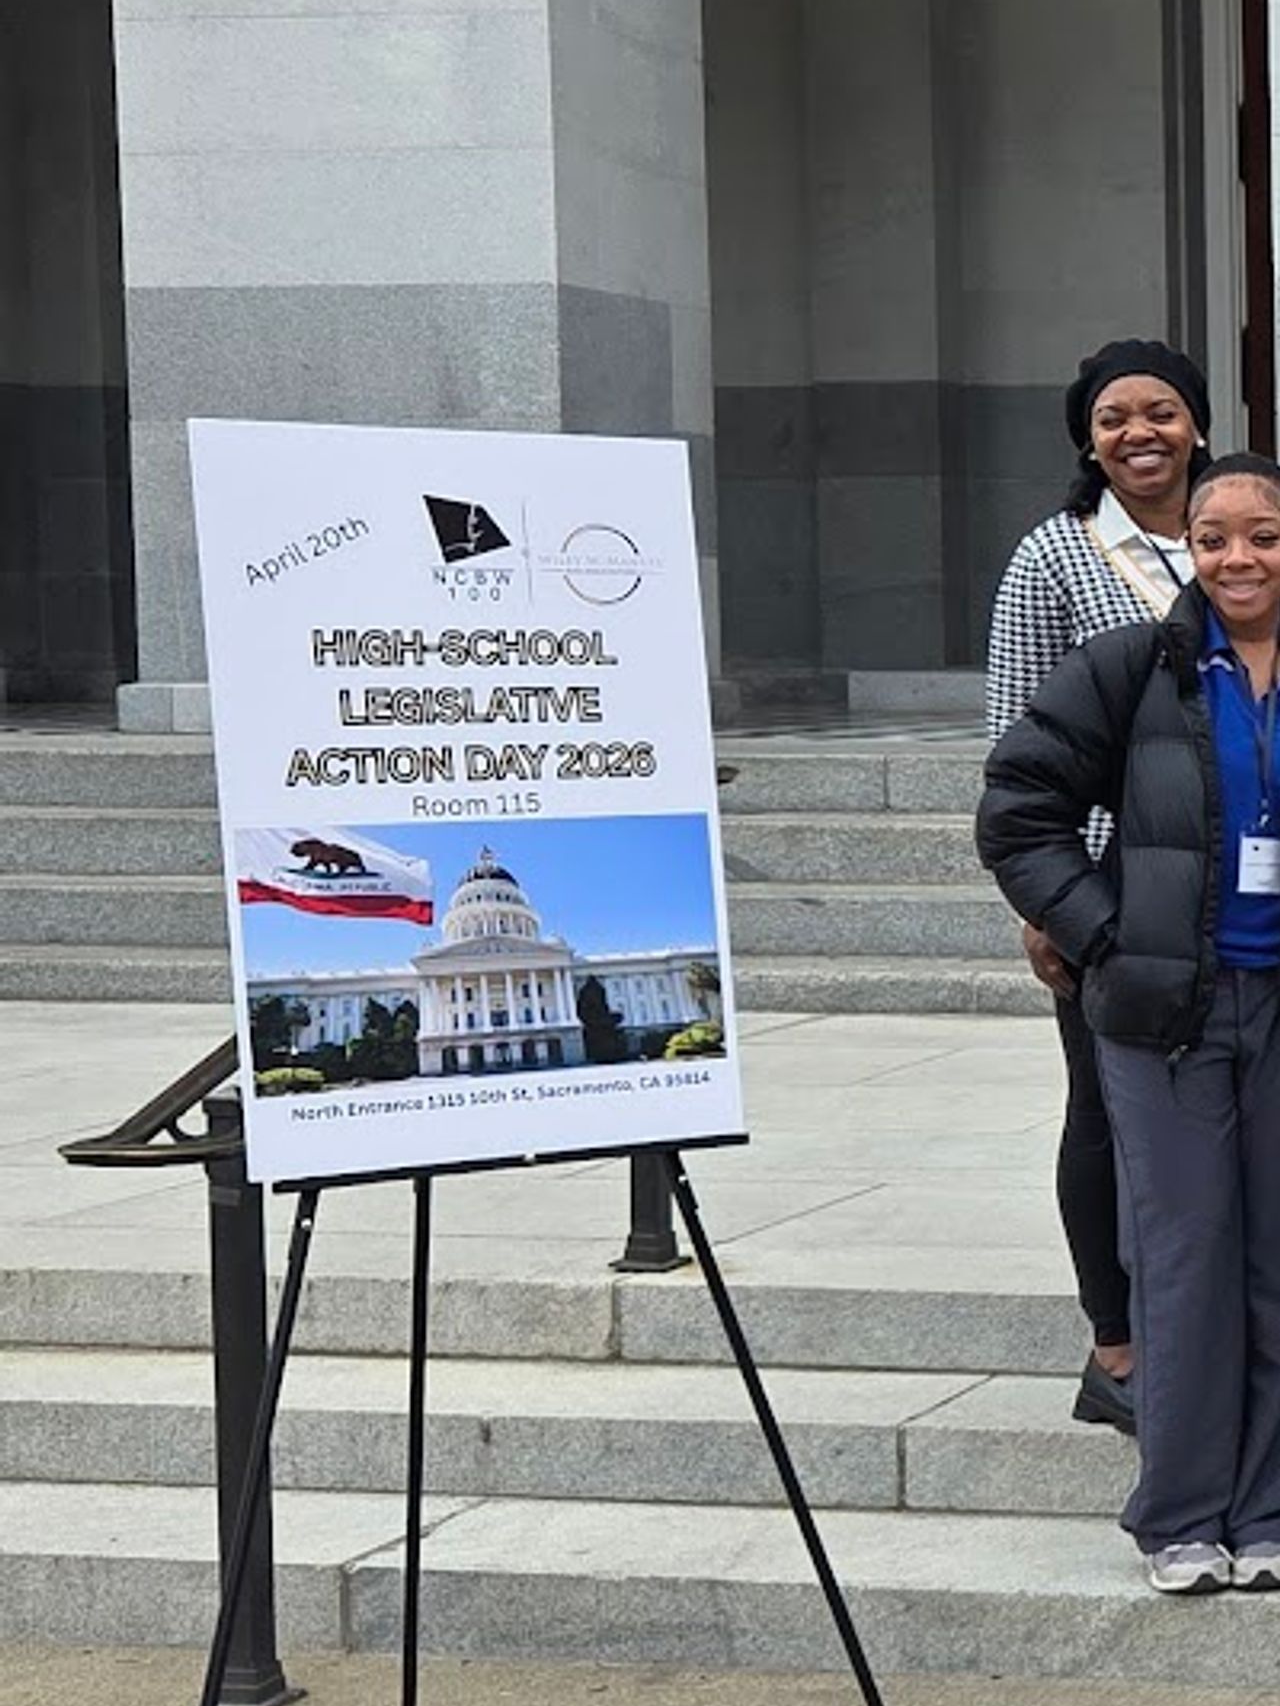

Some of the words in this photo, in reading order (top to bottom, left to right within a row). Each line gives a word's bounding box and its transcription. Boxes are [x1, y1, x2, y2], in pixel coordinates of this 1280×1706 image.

[244, 541, 308, 587] April
[307, 516, 370, 558] 20th
[433, 569, 511, 586] NCBW
[449, 586, 501, 602] 100
[312, 629, 618, 666] HIGH-SCHOOL
[339, 687, 603, 725] LEGISLATIVE
[285, 746, 455, 786] ACTION
[465, 744, 549, 781] DAY
[556, 741, 657, 779] 2026
[412, 795, 488, 816] Room
[496, 793, 541, 814] 115
[291, 1104, 344, 1121] North
[347, 1098, 424, 1117] Entrance
[639, 1074, 662, 1090] CA
